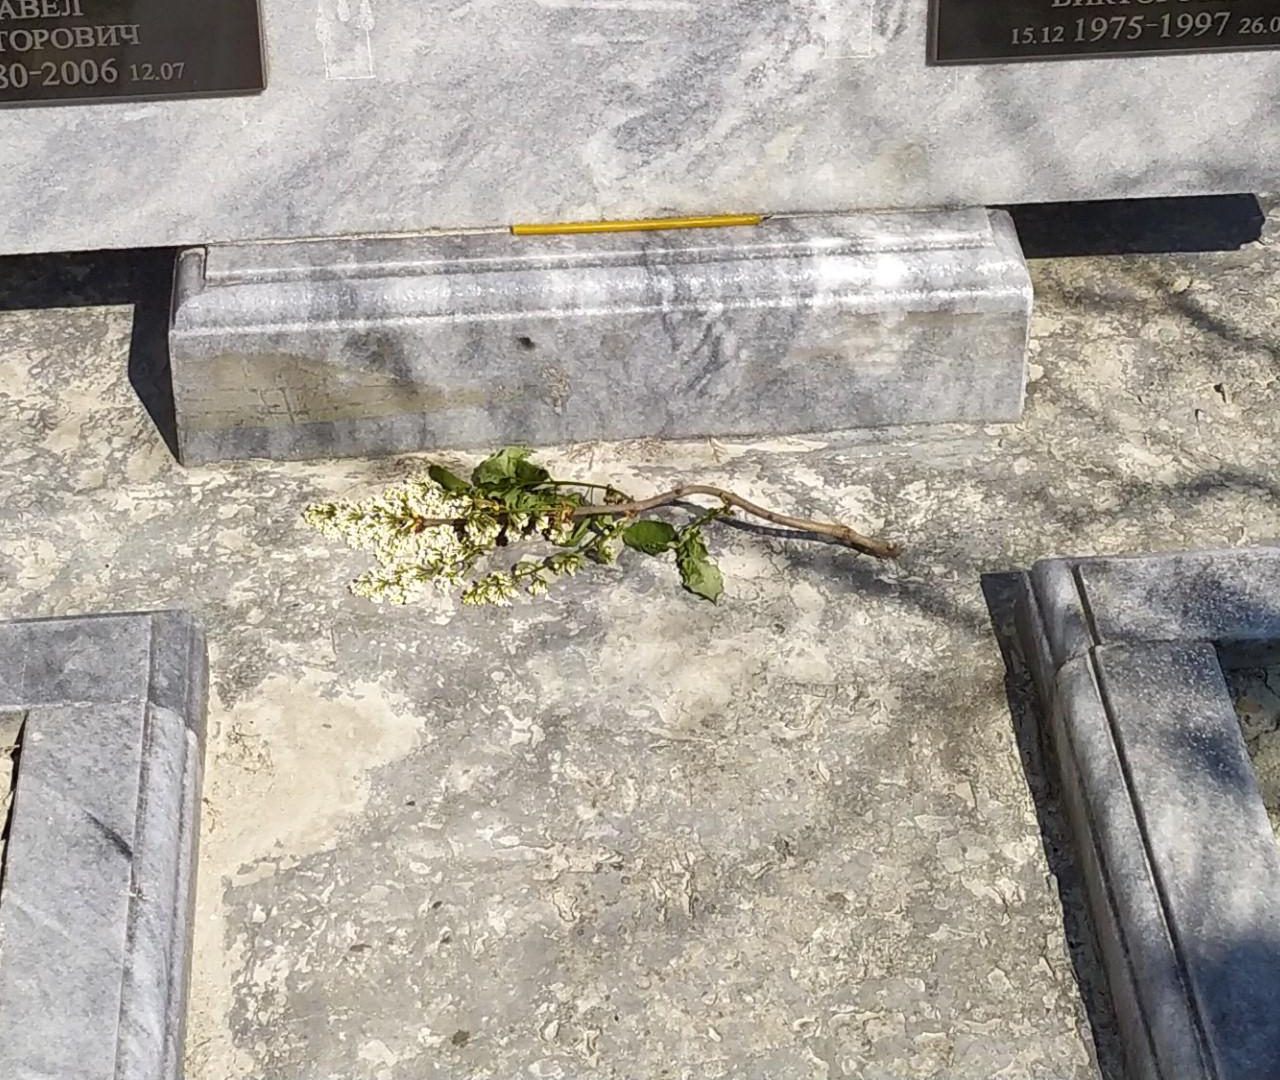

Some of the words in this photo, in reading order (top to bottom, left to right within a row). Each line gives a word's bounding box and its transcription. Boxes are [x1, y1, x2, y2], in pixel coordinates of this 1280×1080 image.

[1011, 25, 1064, 45] 15.12
[1073, 12, 1231, 43] 1975-1997
[129, 62, 185, 81] 12.07
